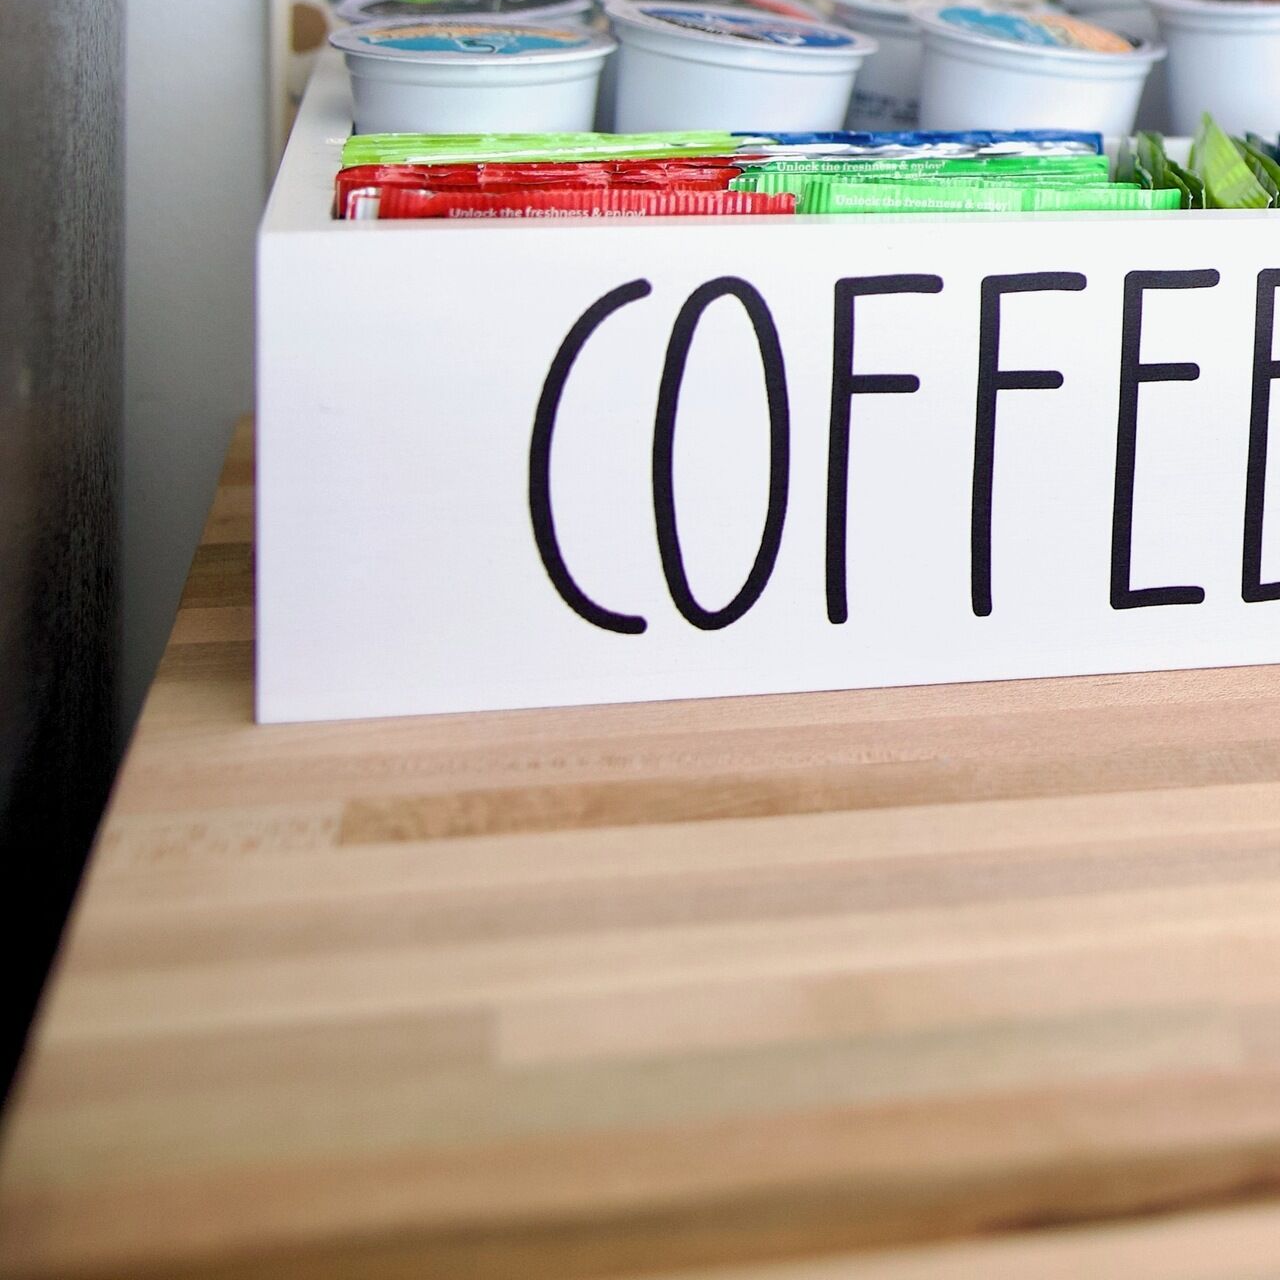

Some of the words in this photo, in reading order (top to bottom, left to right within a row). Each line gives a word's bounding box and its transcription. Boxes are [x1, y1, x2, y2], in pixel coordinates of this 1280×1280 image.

[776, 161, 820, 172] Unlock
[821, 162, 841, 172] the
[898, 161, 908, 171] &
[836, 195, 879, 206] Unlock
[881, 196, 901, 206] the
[903, 196, 962, 208] freshness
[449, 207, 497, 218] Unlock
[500, 207, 523, 218] the
[525, 205, 589, 217] freshness
[591, 206, 602, 216] &
